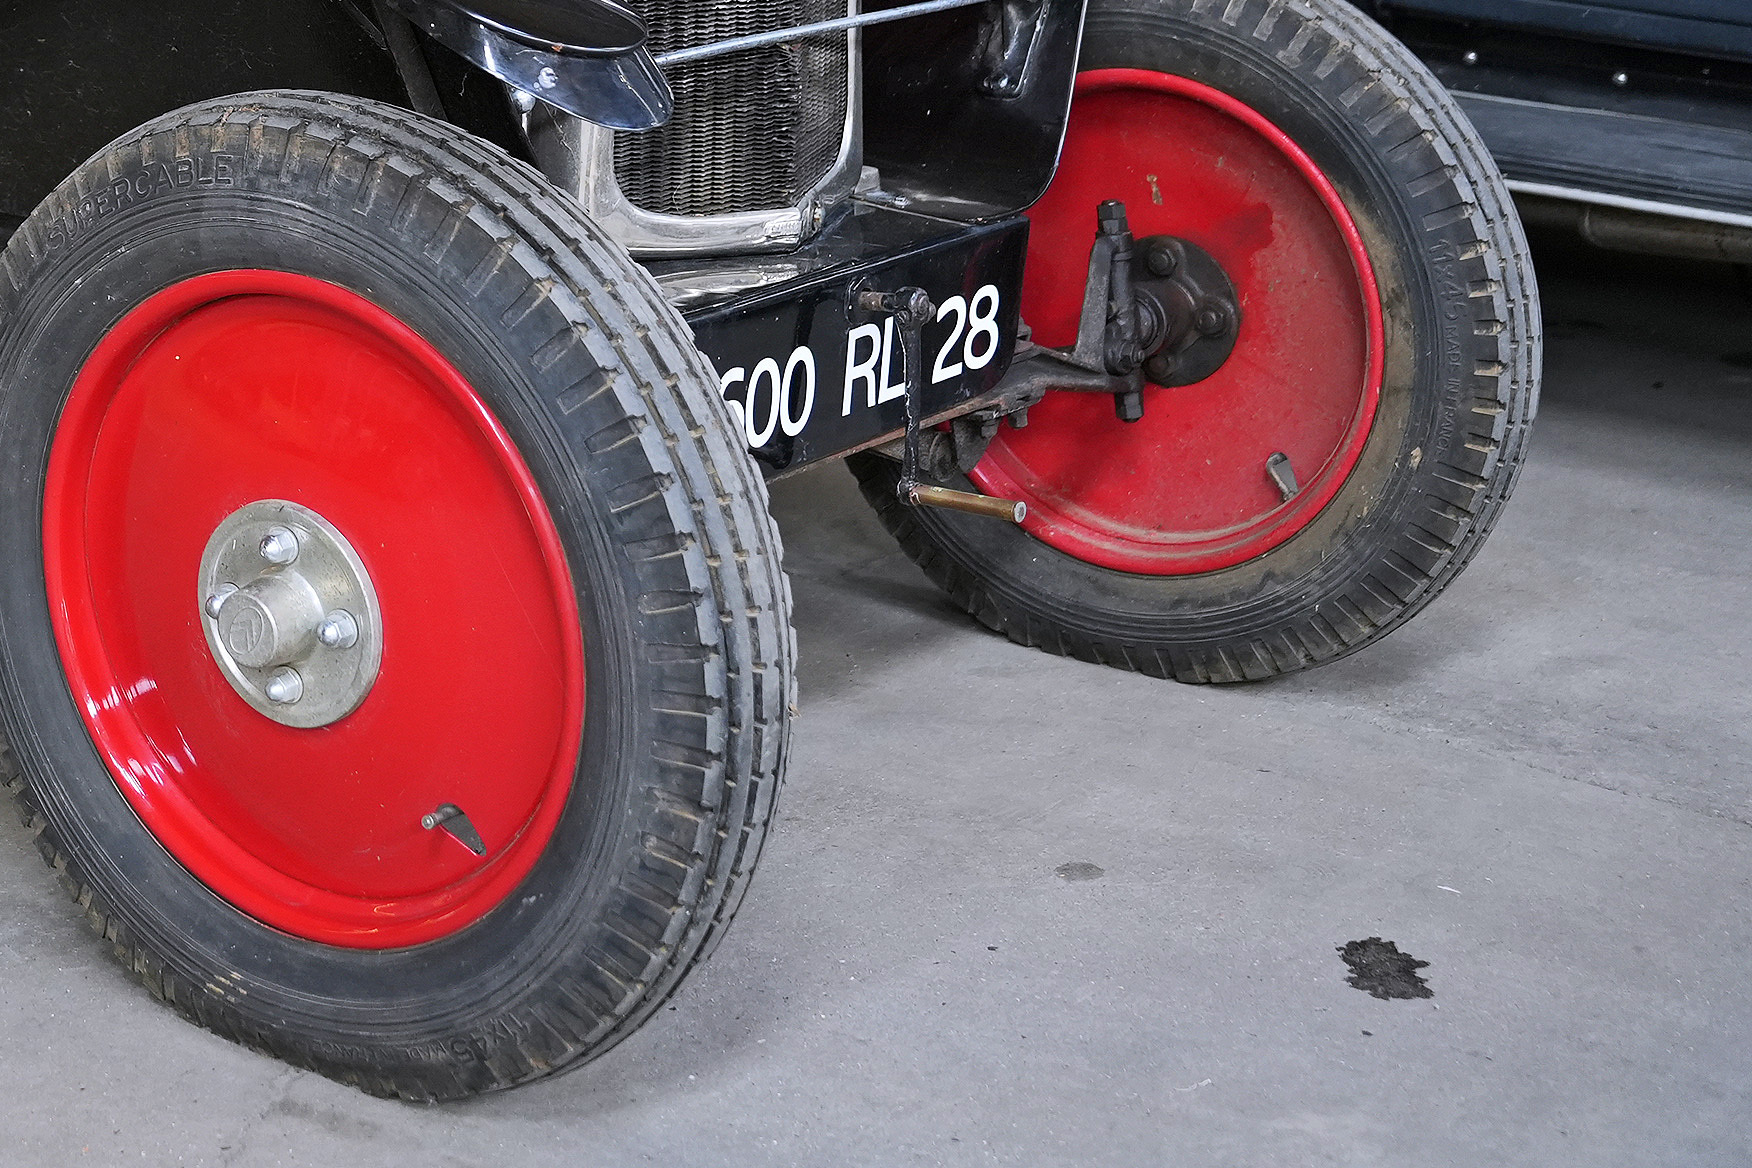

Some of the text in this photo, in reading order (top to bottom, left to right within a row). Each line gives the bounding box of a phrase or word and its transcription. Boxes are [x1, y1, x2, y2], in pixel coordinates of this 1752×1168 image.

[47, 154, 233, 249] SUPERCABLE
[841, 316, 906, 417] RL
[931, 284, 999, 384] 28
